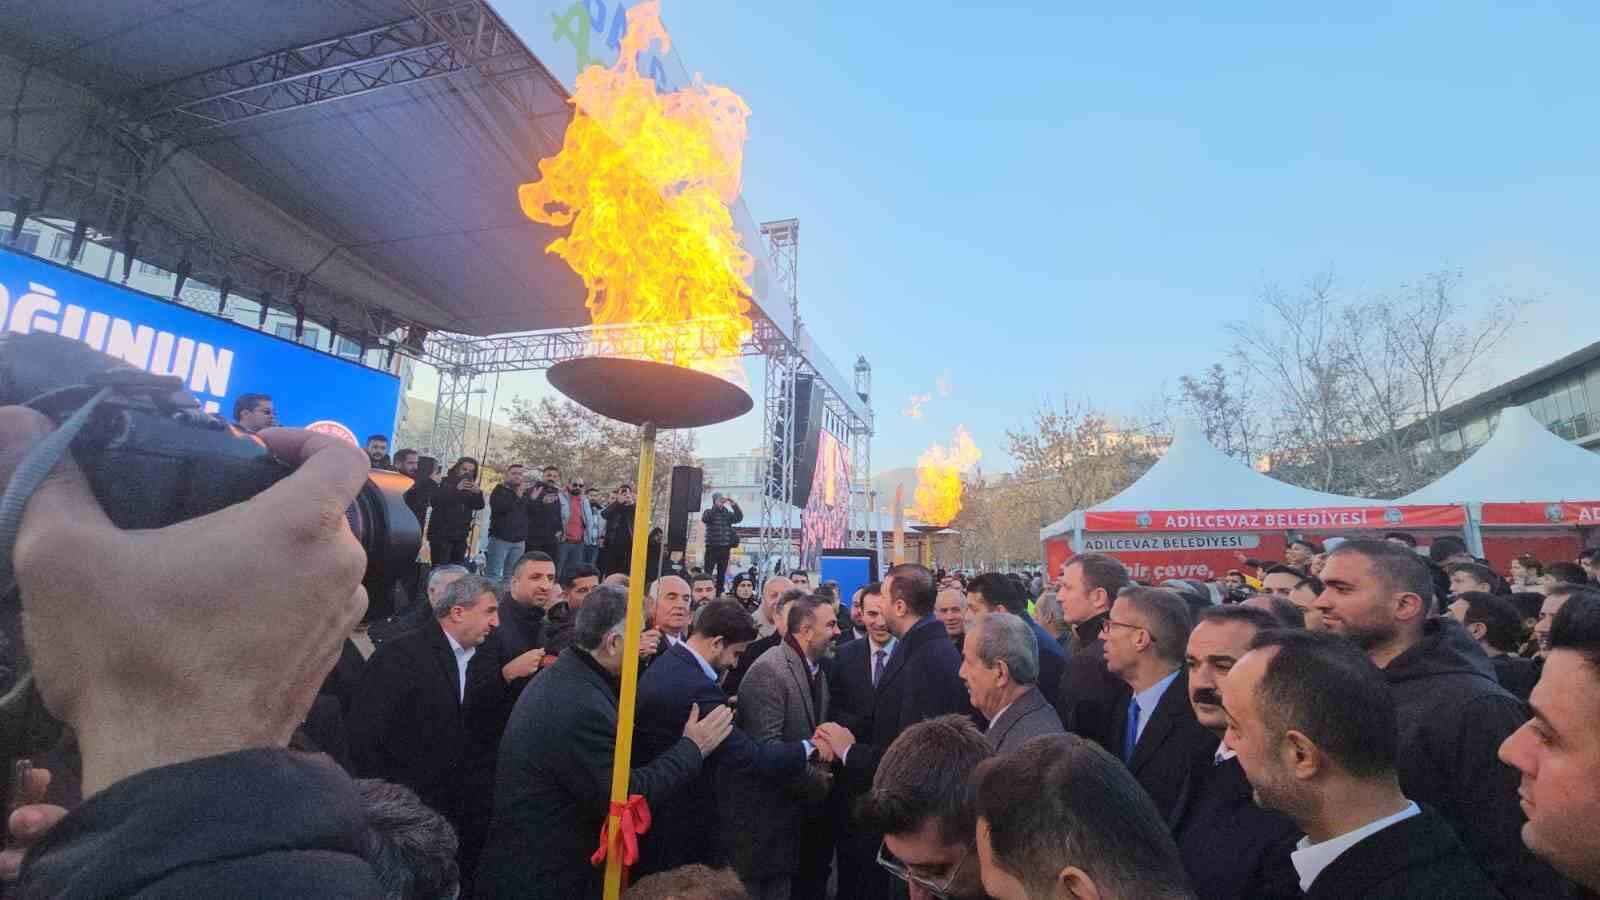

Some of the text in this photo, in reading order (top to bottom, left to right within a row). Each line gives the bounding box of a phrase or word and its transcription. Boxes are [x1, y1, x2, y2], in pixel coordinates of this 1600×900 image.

[1165, 509, 1368, 528] ADİLCEVAZ BELEDİYESİ
[1154, 563, 1214, 580] çevre,
